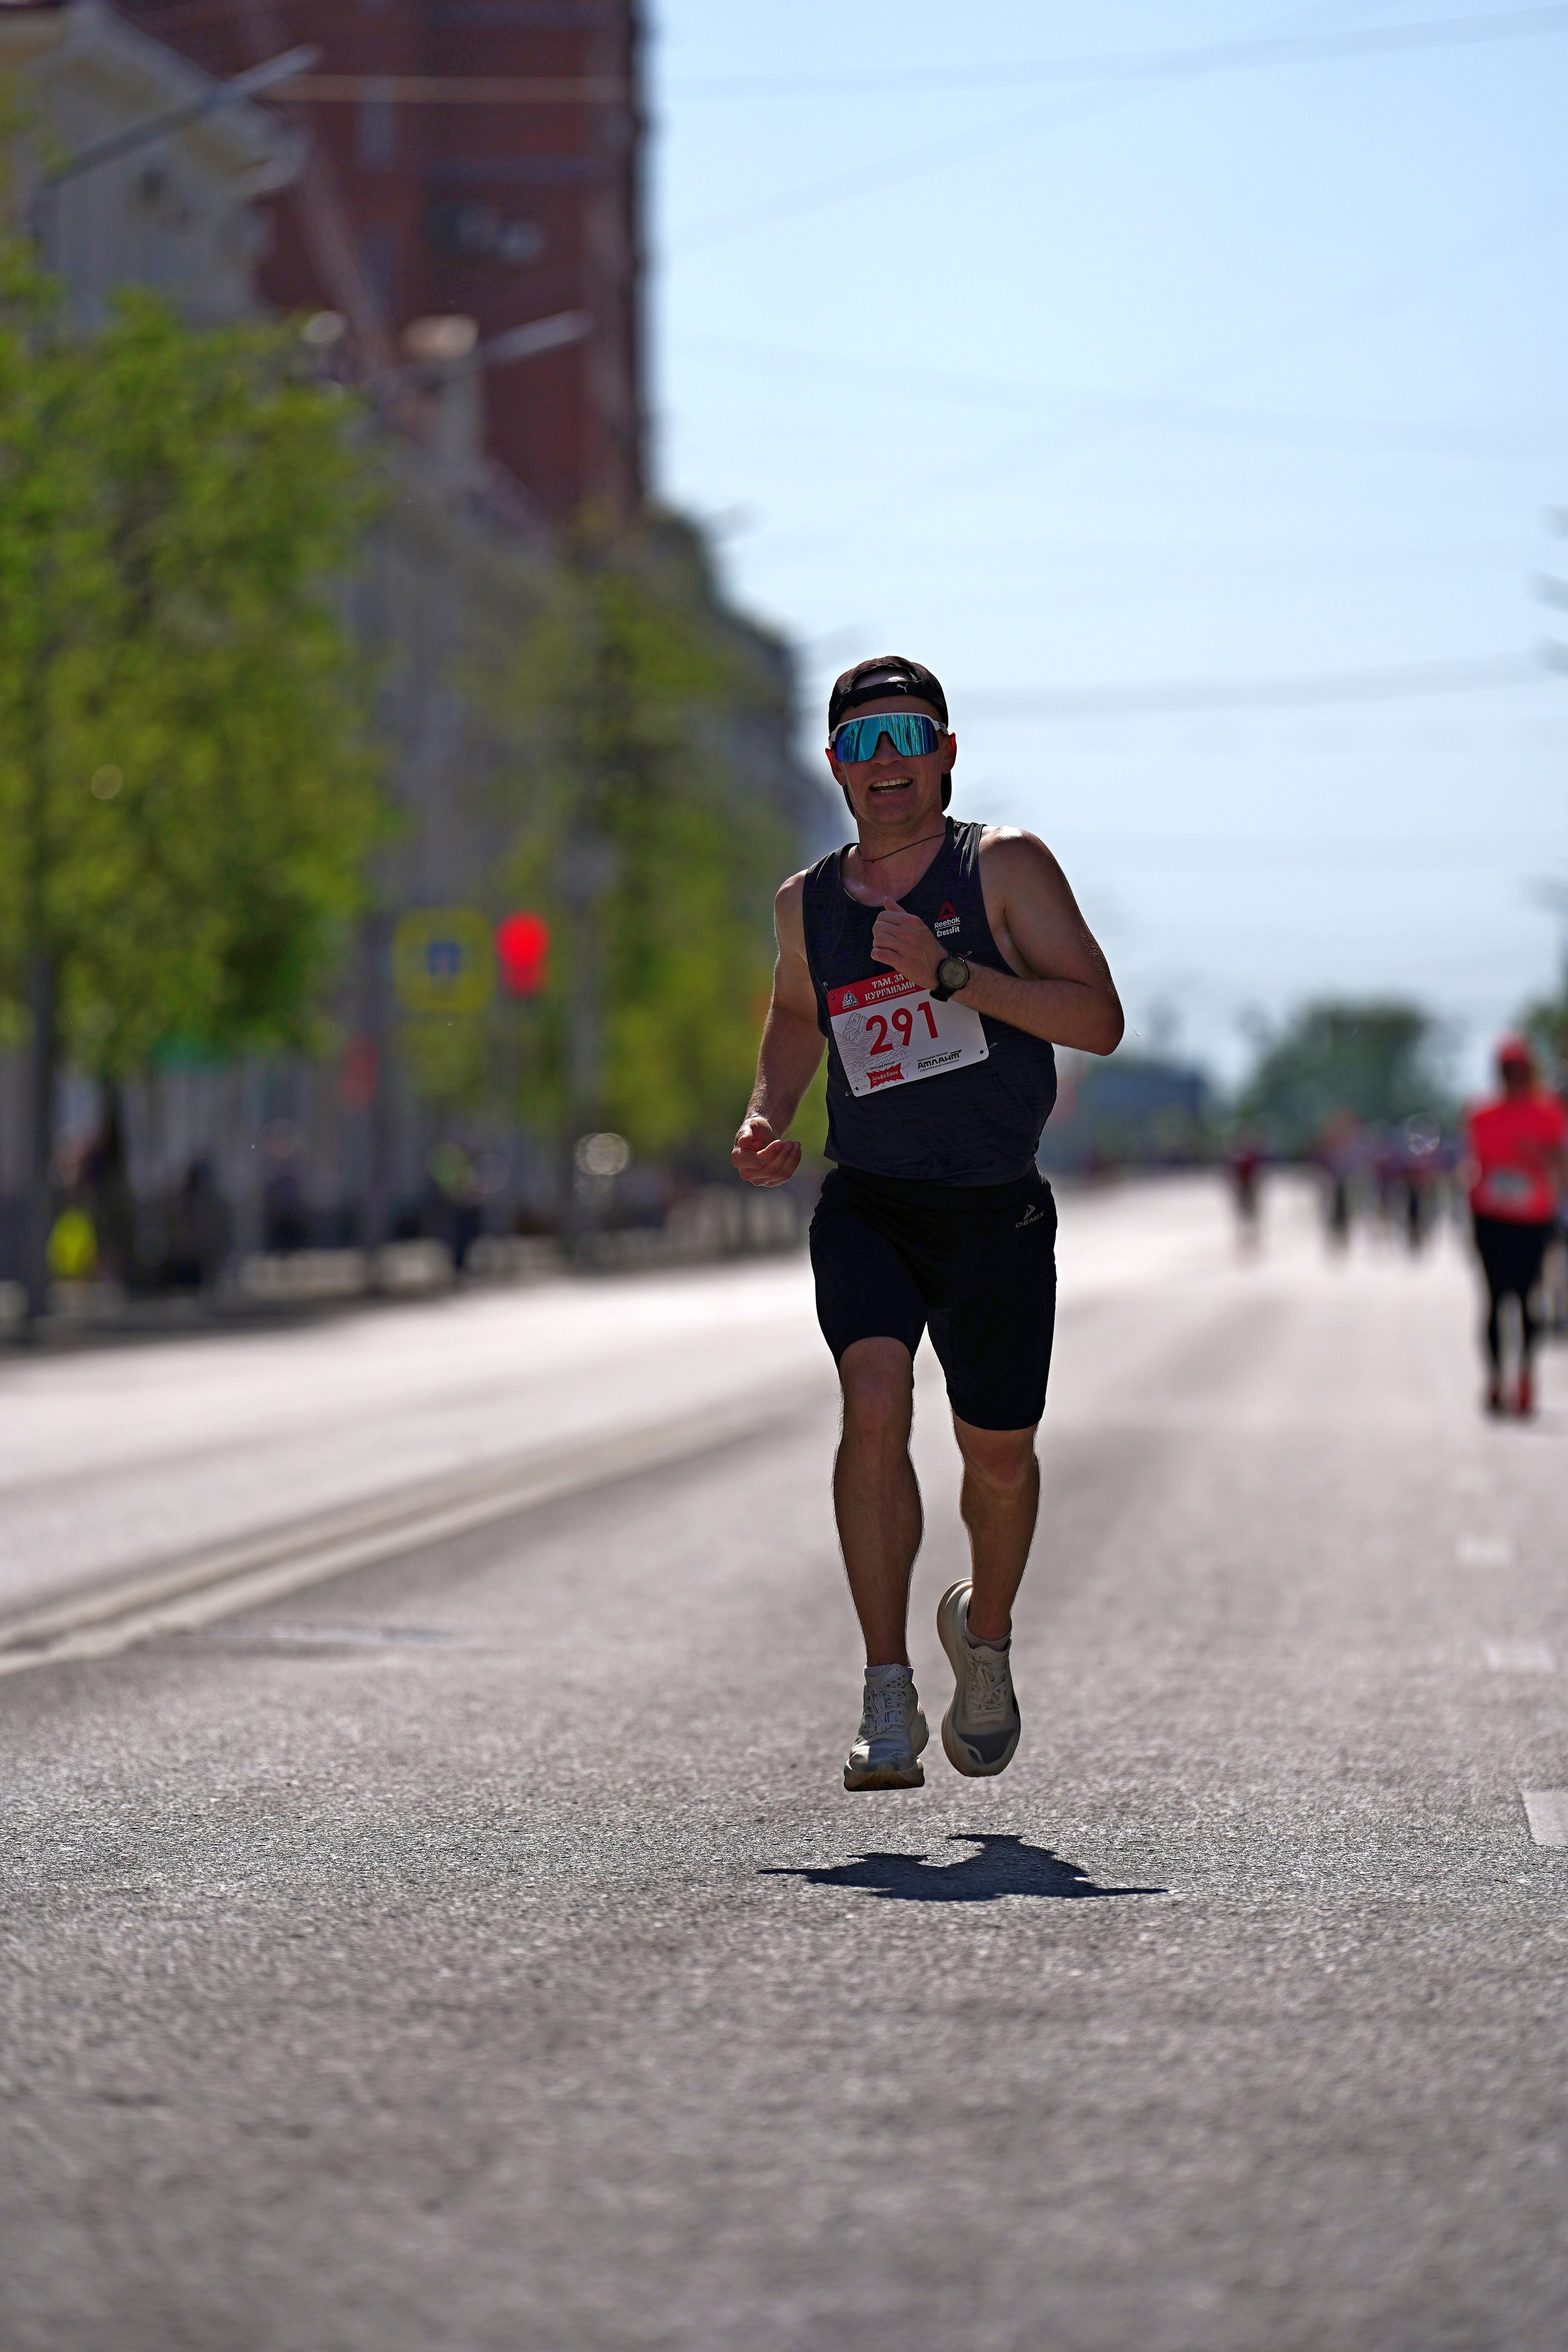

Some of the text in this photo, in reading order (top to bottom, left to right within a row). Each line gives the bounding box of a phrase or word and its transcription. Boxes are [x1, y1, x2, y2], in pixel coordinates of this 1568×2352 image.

[934, 916, 960, 929] Reebok
[937, 926, 960, 937] CrossFit
[871, 973, 905, 989] ТАМ, ЗА
[864, 981, 916, 1001] КУРГАНАМИ
[865, 1001, 939, 1056] 291
[872, 1074, 886, 1082] Альфа
[1015, 1211, 1045, 1229] DEMIX
